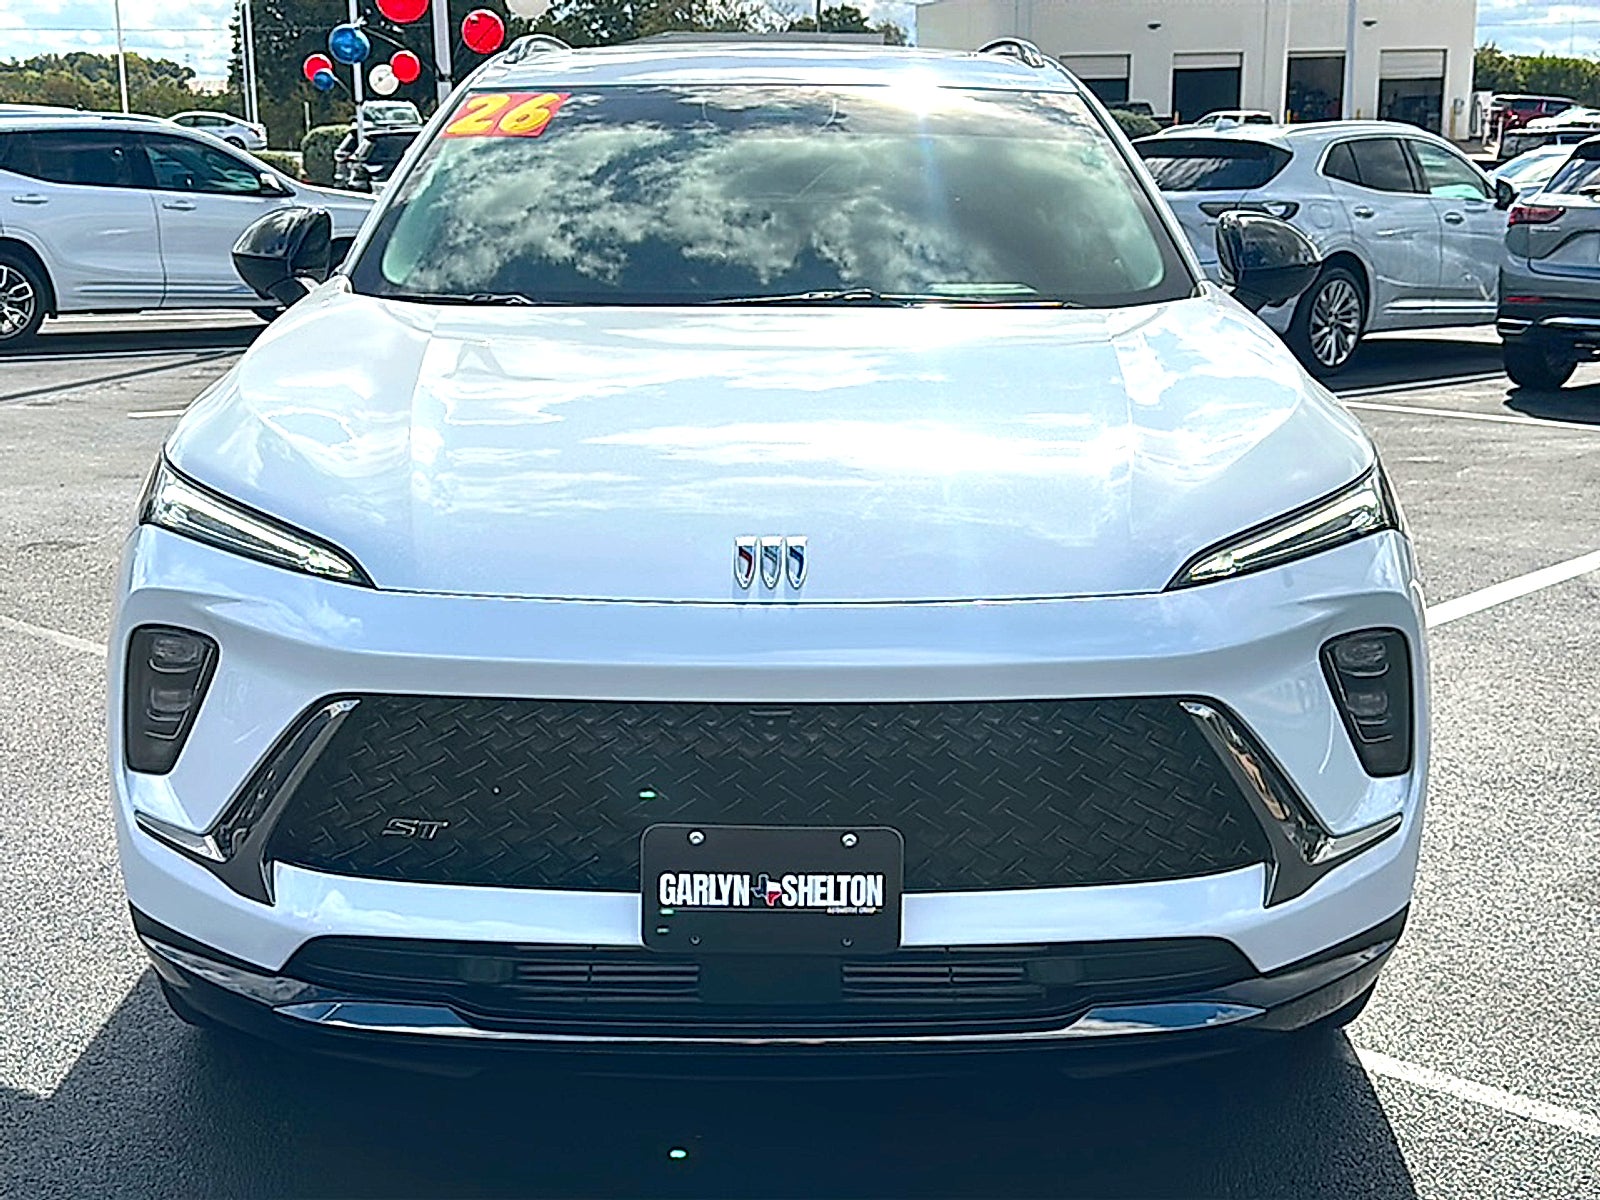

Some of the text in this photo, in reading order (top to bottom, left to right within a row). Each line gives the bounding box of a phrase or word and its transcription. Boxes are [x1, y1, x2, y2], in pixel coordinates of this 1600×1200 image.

[446, 93, 561, 134] 26
[381, 818, 449, 839] ST
[659, 873, 883, 907] GARLYN SHELTON
